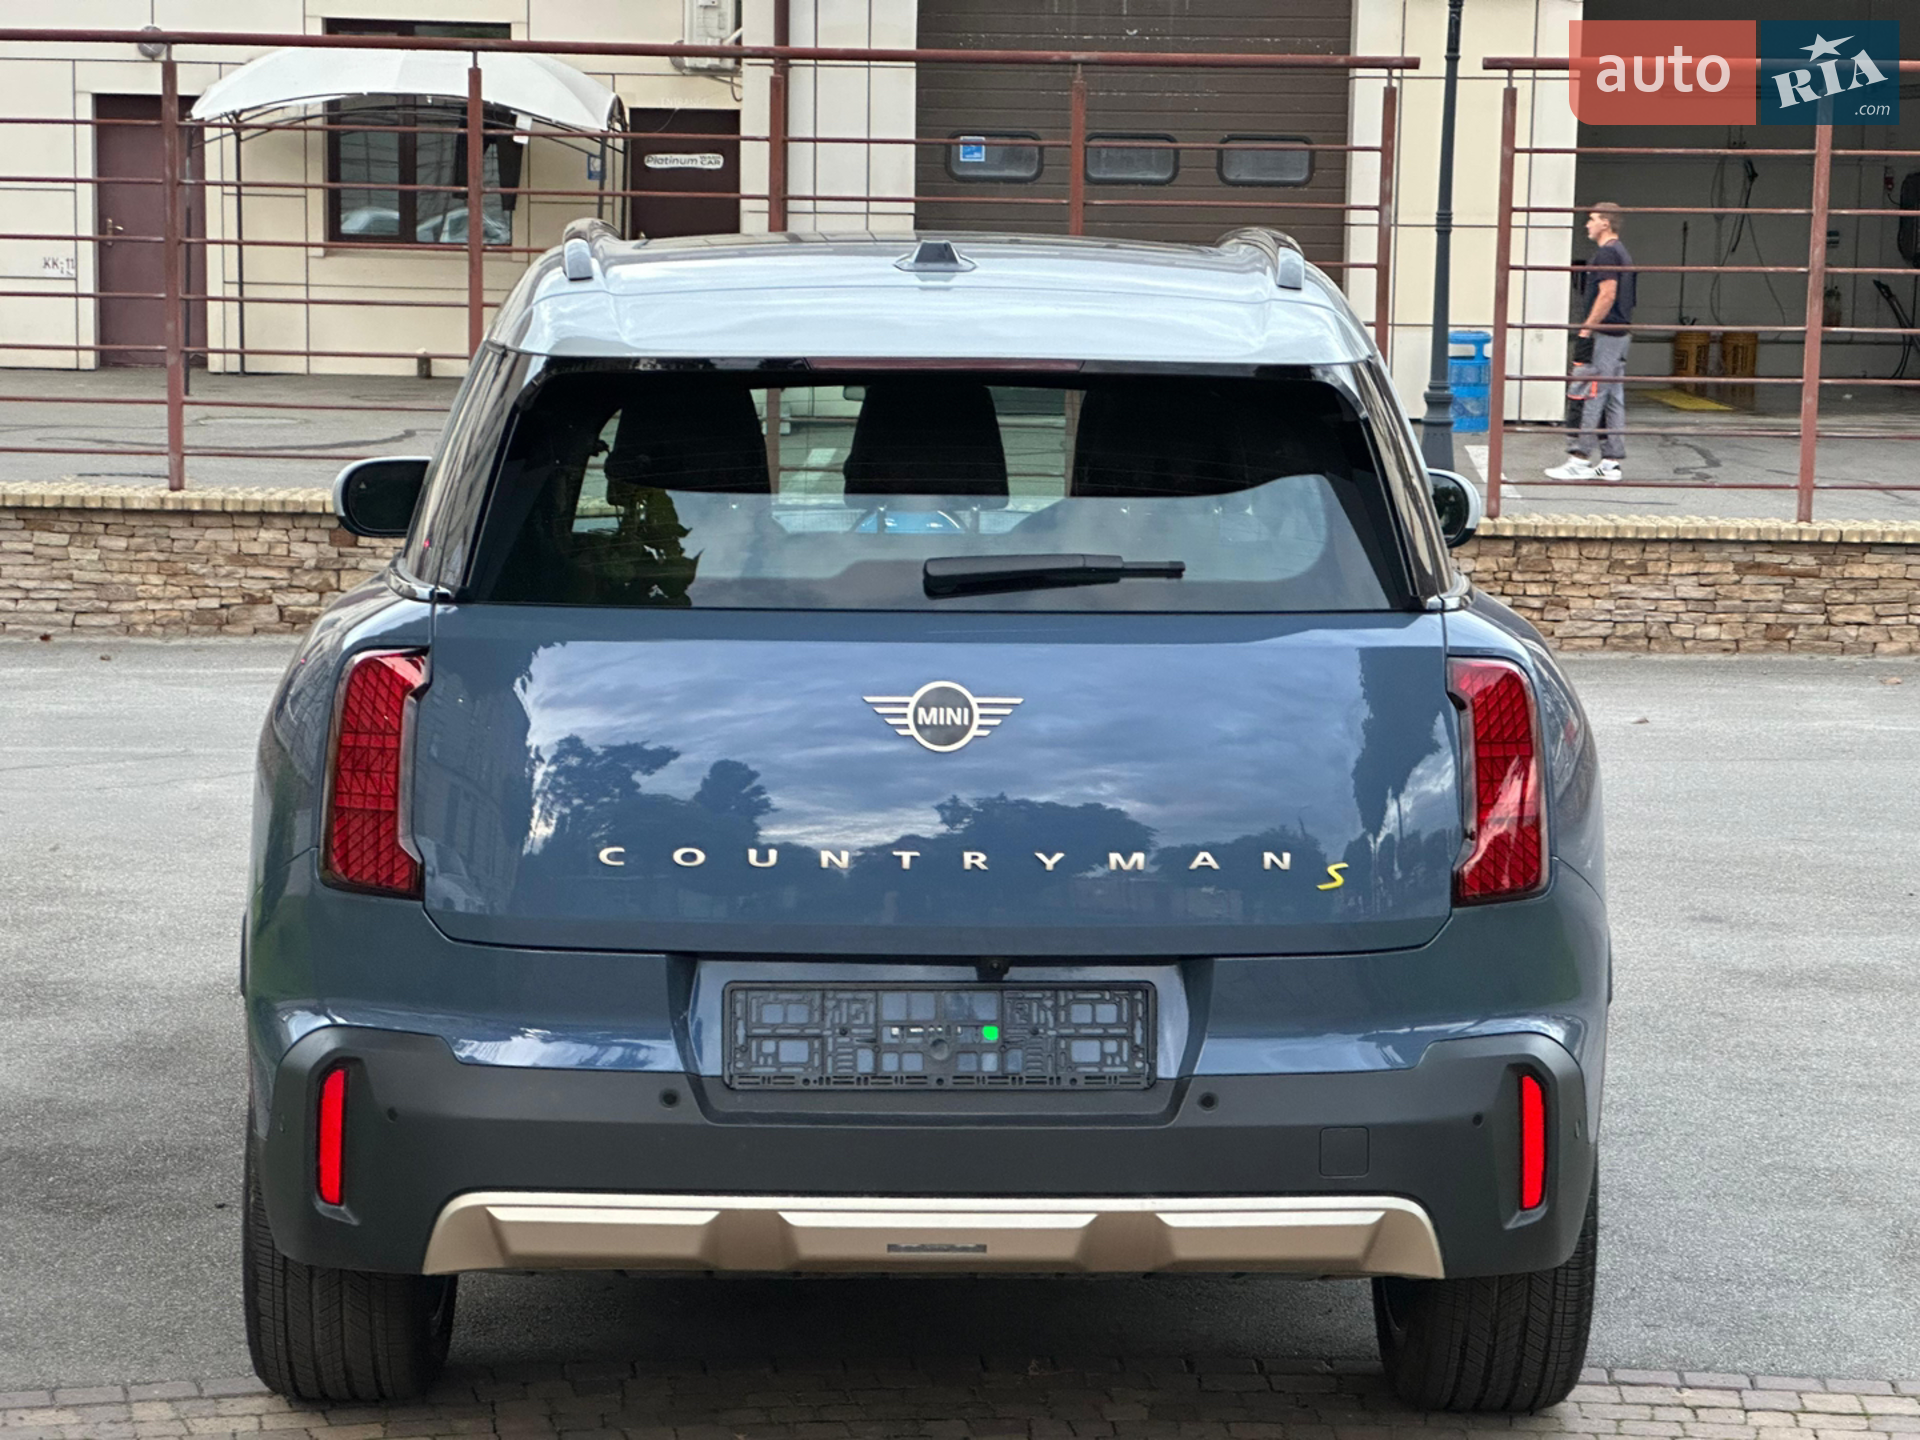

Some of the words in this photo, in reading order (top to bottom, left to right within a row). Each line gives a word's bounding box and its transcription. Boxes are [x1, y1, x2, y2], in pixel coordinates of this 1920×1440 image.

[646, 154, 698, 166] Platinum
[917, 707, 969, 726] MINI
[598, 844, 1293, 873] COUNTRYMAN
[1316, 861, 1348, 890] S
